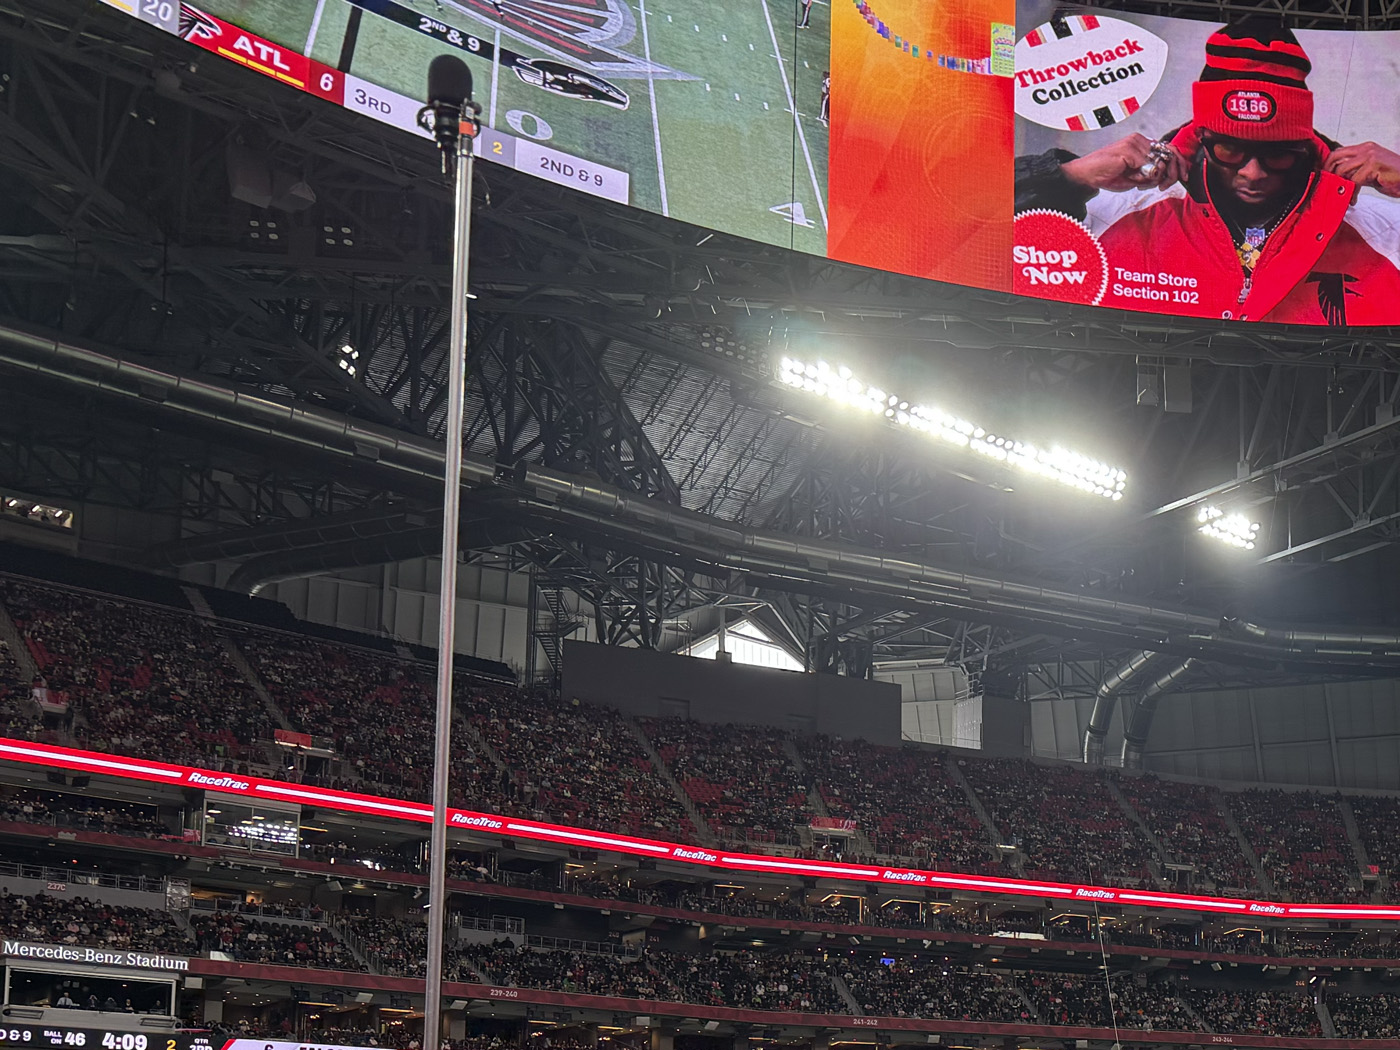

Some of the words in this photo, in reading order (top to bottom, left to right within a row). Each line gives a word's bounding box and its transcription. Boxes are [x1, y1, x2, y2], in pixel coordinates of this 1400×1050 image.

[142, 0, 174, 22] 20
[418, 17, 447, 34] 2ND
[446, 31, 463, 47] &
[467, 37, 481, 52] 9
[233, 35, 291, 71] ATL
[1015, 37, 1144, 89] Throwback
[319, 73, 333, 91] 6
[1031, 60, 1145, 105] Collection
[354, 88, 392, 115] 3RD
[1230, 98, 1268, 113] 1966
[492, 141, 503, 155] 2
[540, 156, 574, 178] 2ND
[578, 169, 590, 182] &
[594, 174, 604, 187] 9
[1013, 245, 1078, 268] Shop
[1022, 267, 1088, 285] Now
[1114, 267, 1155, 284] Team
[1158, 272, 1198, 288] Store
[1113, 283, 1169, 302] Section
[1172, 290, 1199, 304] 102
[188, 772, 250, 791] RaceTrac
[452, 814, 502, 829] RaceTrac
[673, 848, 717, 862] RaceTrac
[883, 870, 927, 883] RaceTrac
[47, 883, 66, 891] 237C
[1076, 888, 1115, 900] RaceTrac
[1249, 904, 1285, 914] RaceTrac
[4, 941, 122, 965] Mercedes-Benz
[126, 952, 189, 970] Stadium
[490, 989, 518, 998] 239-240
[10, 1030, 21, 1041] &
[24, 1031, 32, 1042] 9
[64, 1031, 86, 1046] 46
[102, 1032, 148, 1050] 4:09
